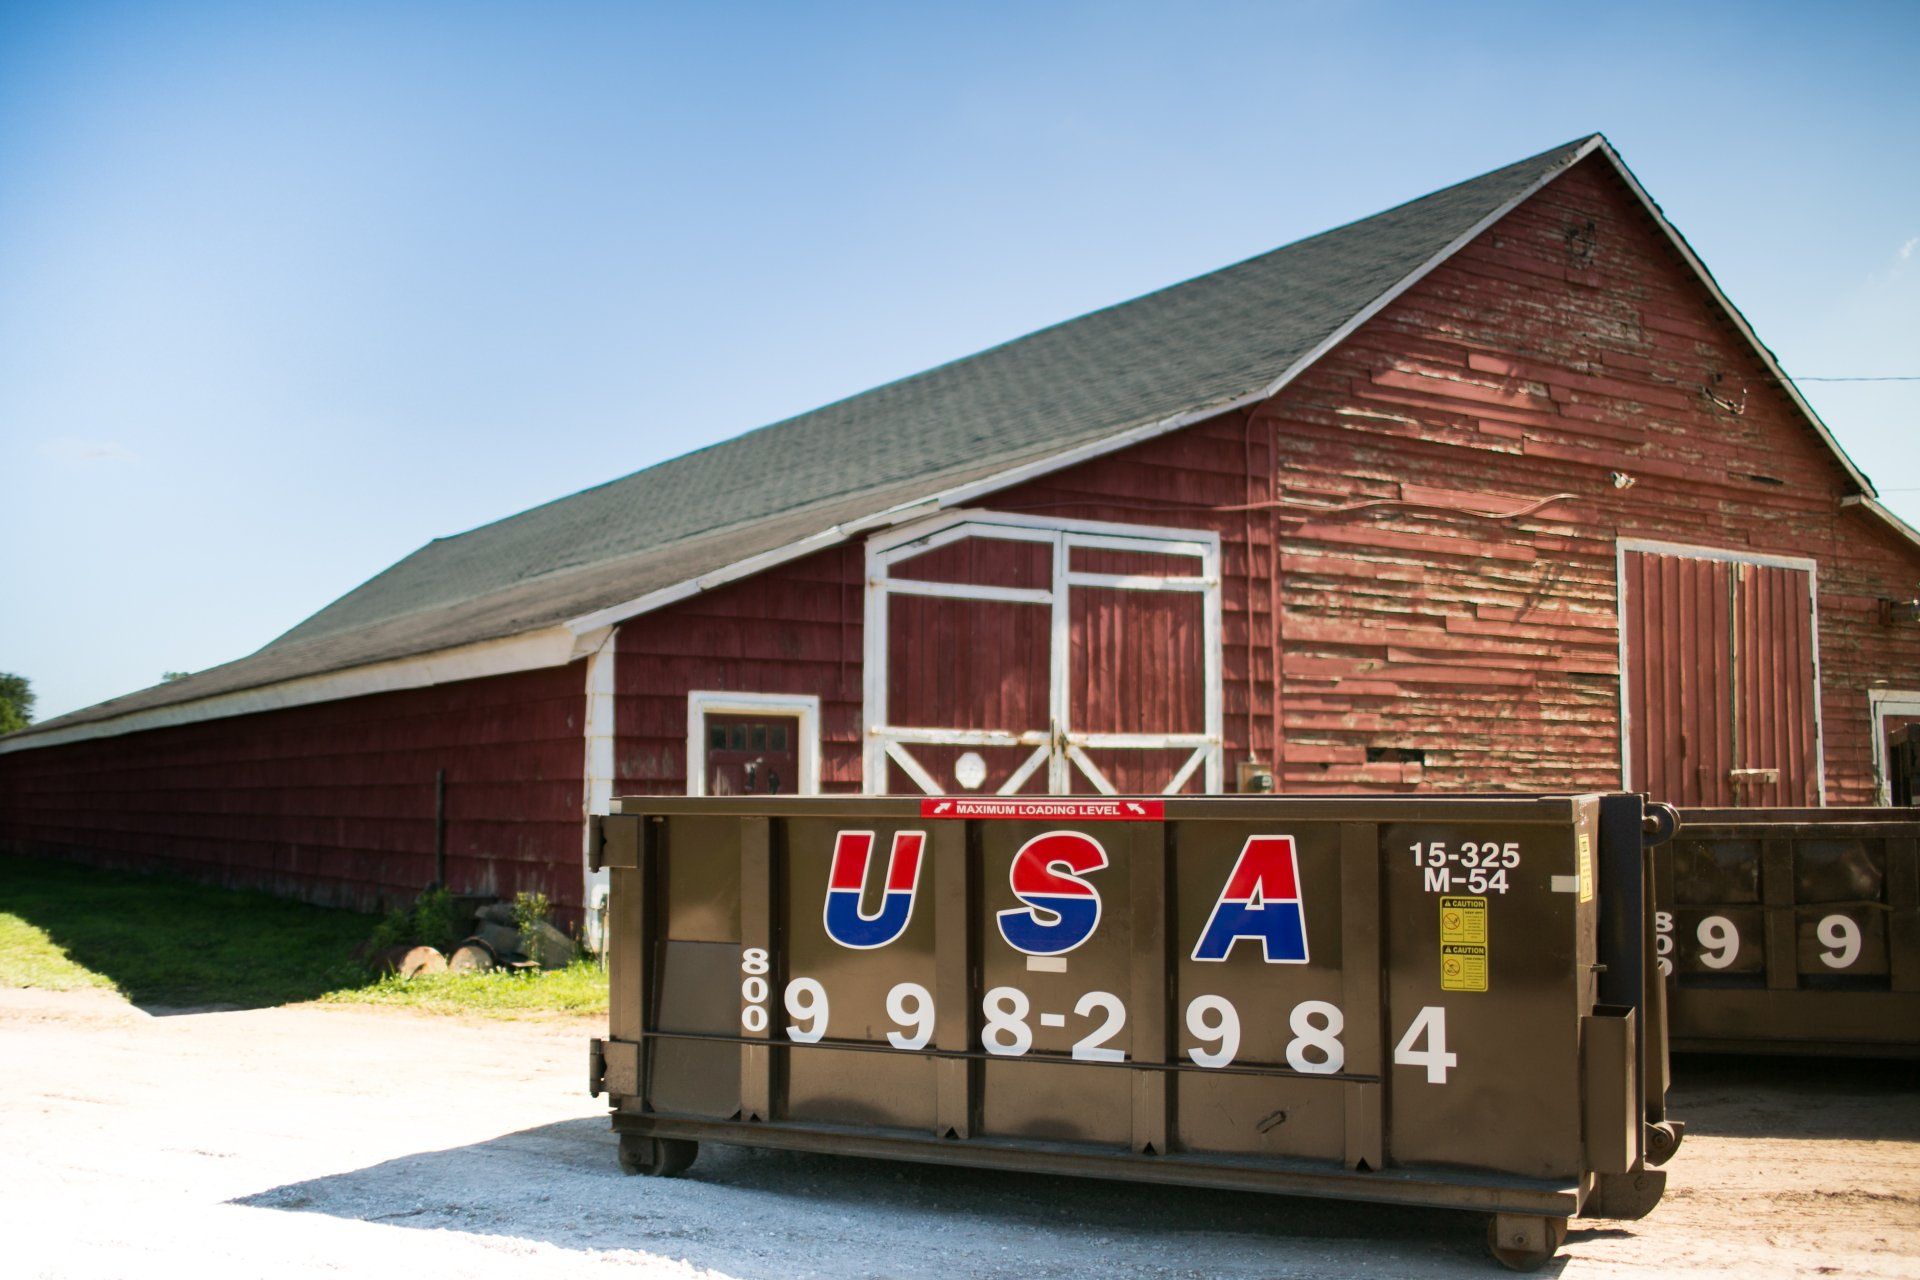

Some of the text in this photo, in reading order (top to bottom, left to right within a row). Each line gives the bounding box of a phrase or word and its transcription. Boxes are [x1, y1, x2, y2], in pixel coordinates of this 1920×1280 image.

[956, 805, 1121, 816] MAXIMUM LOADING LEVEL
[1409, 842, 1520, 868] 15-325
[1424, 867, 1510, 894] M-54
[1452, 900, 1484, 908] CAUTION
[1452, 946, 1484, 954] CAUTION
